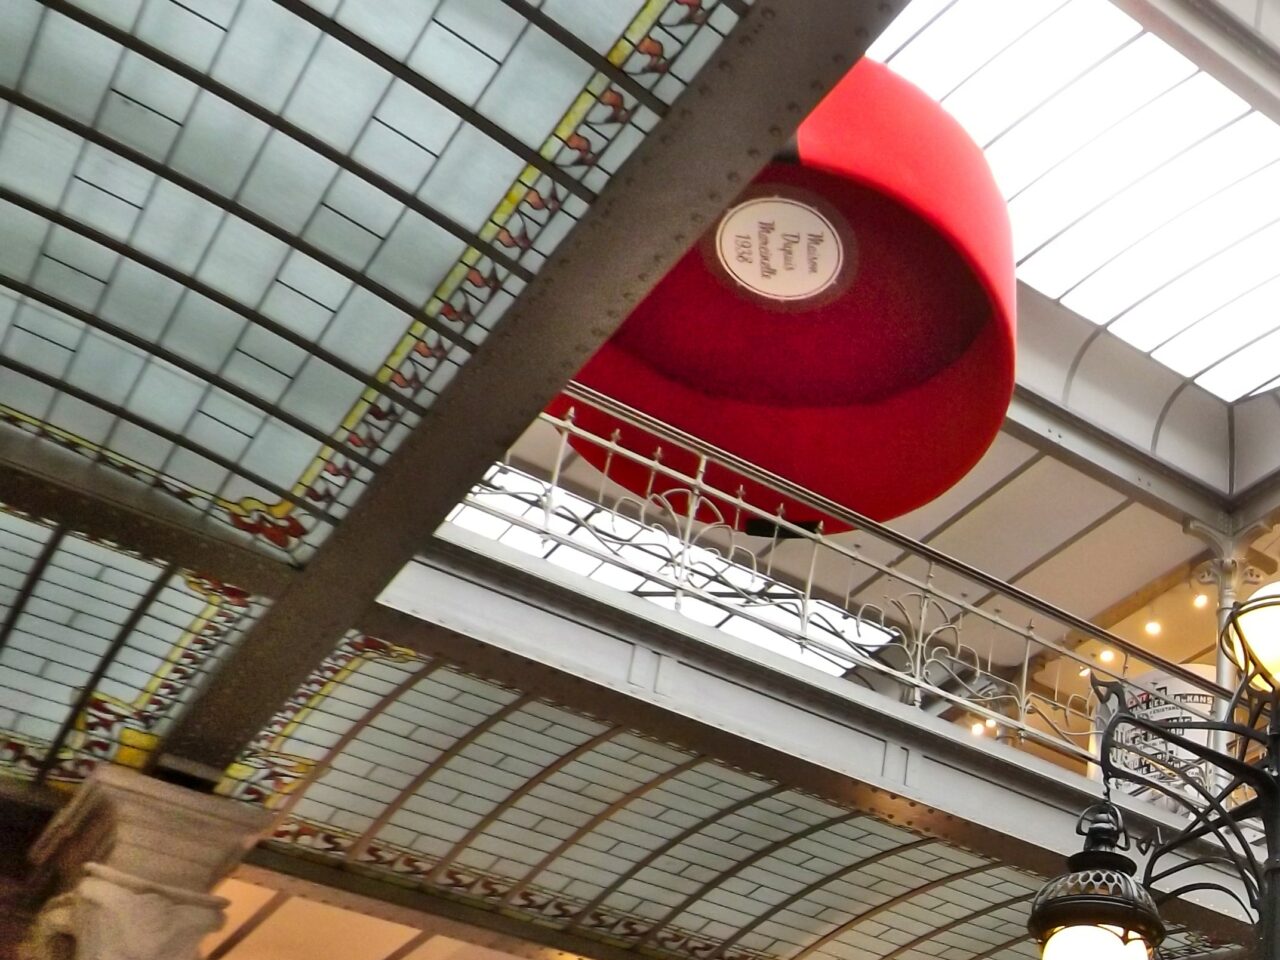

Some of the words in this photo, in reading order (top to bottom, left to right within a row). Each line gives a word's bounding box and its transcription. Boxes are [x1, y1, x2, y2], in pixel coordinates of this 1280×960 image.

[735, 234, 753, 265] 1938
[779, 232, 801, 271] Dupuis
[807, 231, 825, 275] Maison
